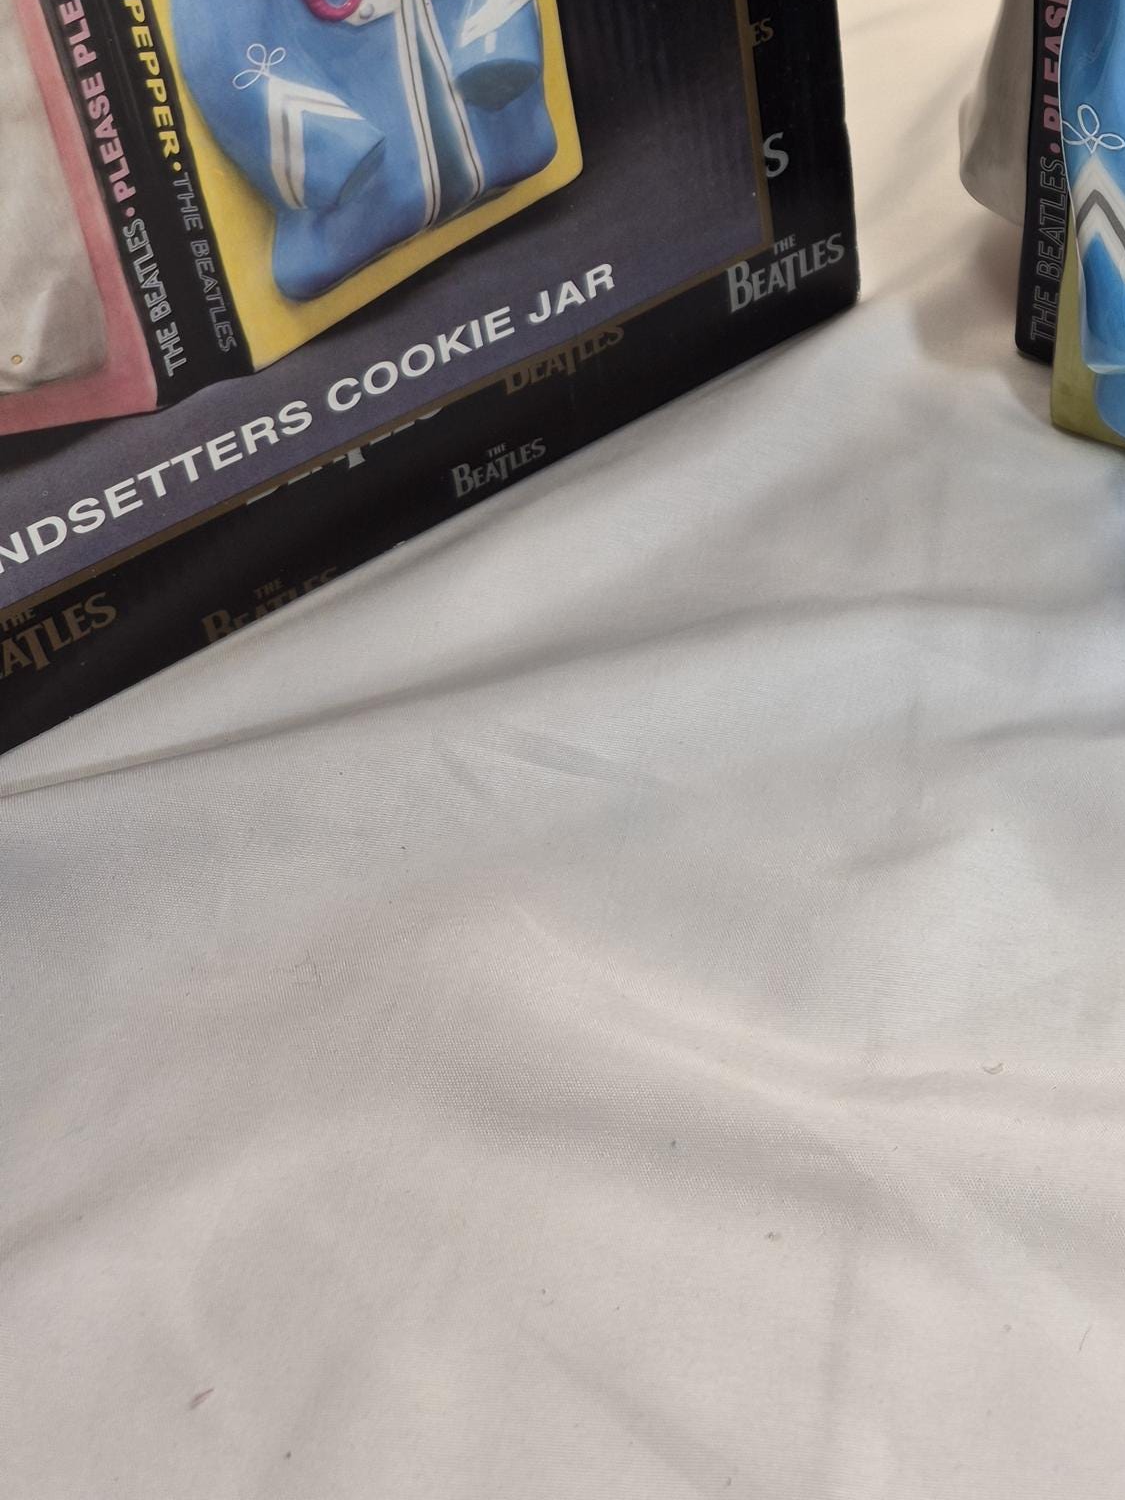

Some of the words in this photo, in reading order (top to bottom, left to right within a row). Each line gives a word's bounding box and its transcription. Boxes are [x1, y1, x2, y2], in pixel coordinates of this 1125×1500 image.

[80, 70, 138, 204] PLEASE
[122, 217, 173, 323] BEATLES
[173, 171, 204, 232] THE
[190, 239, 238, 353] BEATLES
[773, 234, 797, 257] THE
[1036, 155, 1068, 282] BEATLES
[725, 232, 845, 313] BEATLES
[156, 322, 187, 378] THE
[326, 306, 516, 412] COOKIE
[528, 263, 615, 324] JAR
[451, 437, 547, 498] BEATLES
